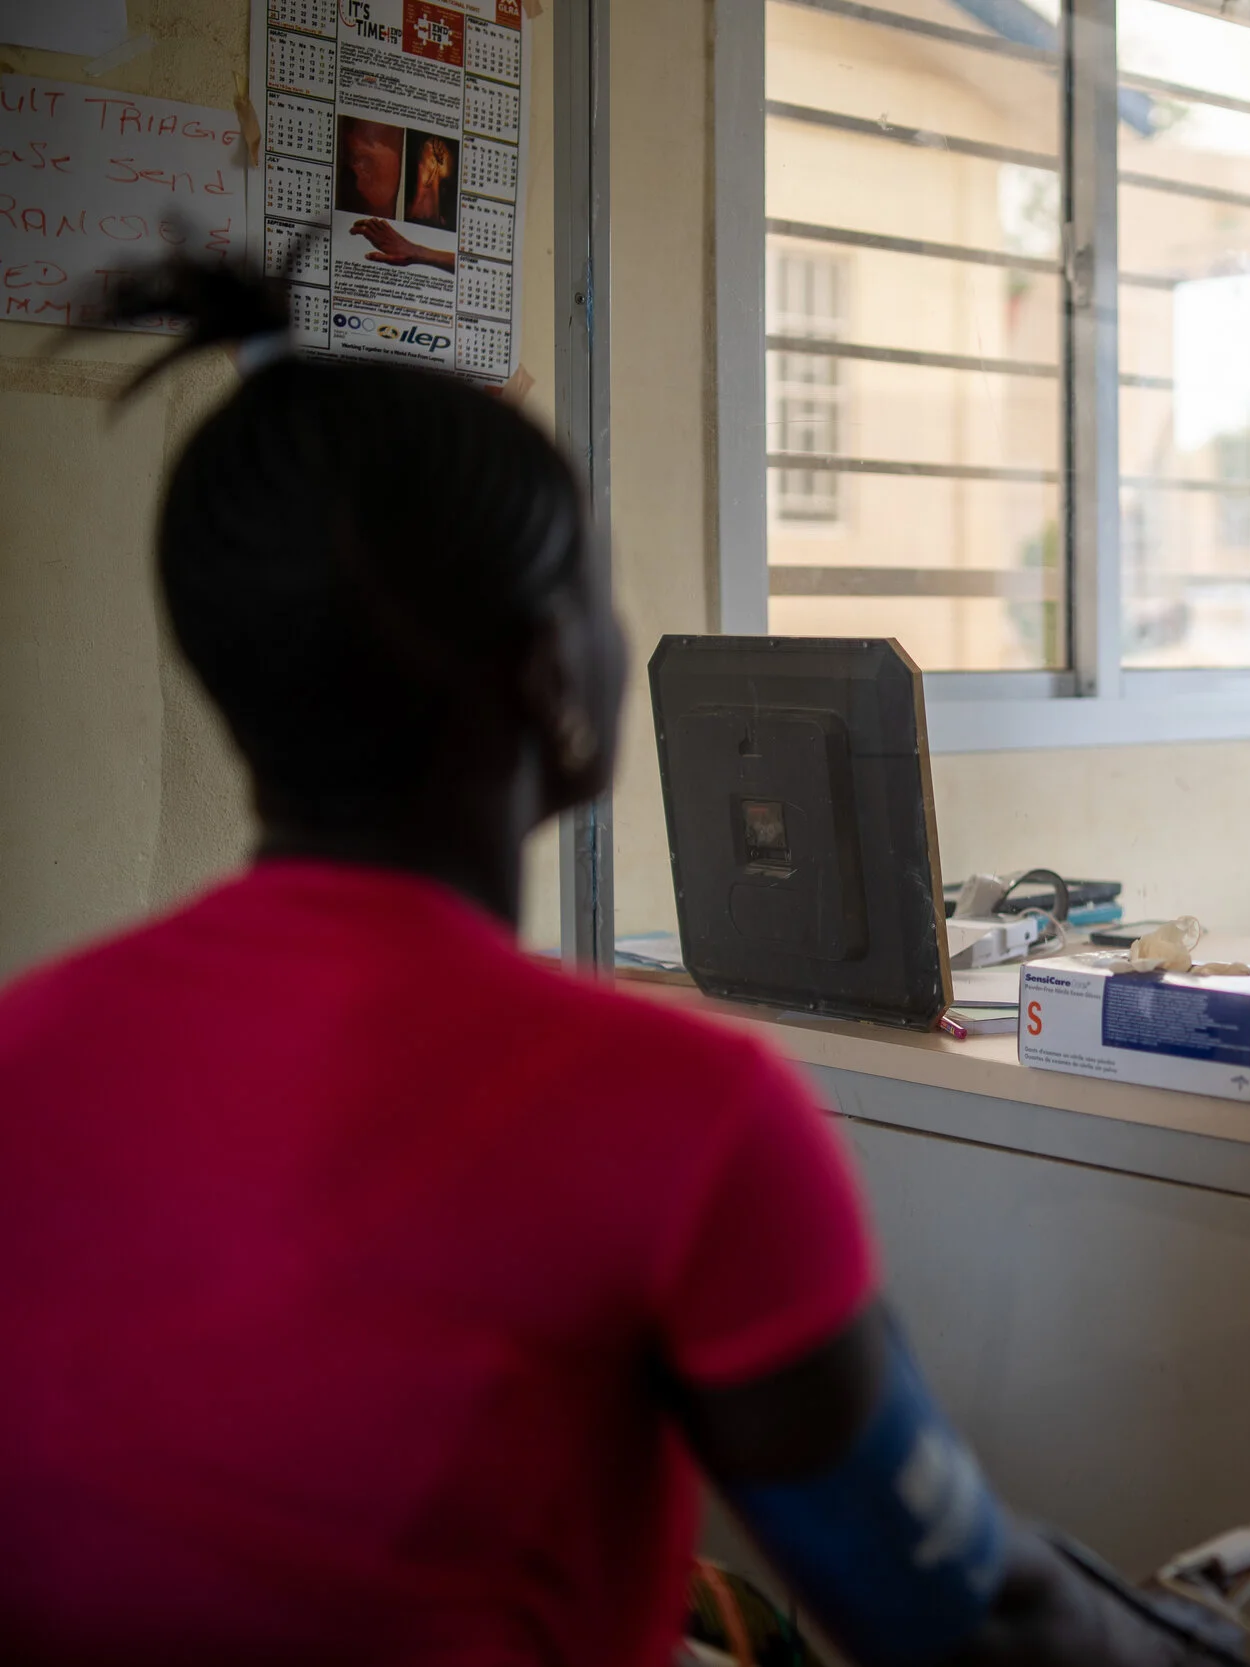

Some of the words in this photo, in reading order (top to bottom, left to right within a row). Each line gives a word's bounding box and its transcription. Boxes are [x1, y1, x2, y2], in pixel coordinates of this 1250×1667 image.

[348, 1, 370, 20] IT'S
[355, 19, 385, 41] TIME
[432, 24, 448, 35] END
[432, 33, 442, 42] TB
[267, 220, 295, 228] SEPTEMBER
[400, 325, 451, 352] ilep
[1025, 973, 1071, 987] SensiCare
[1027, 1000, 1042, 1036] S
